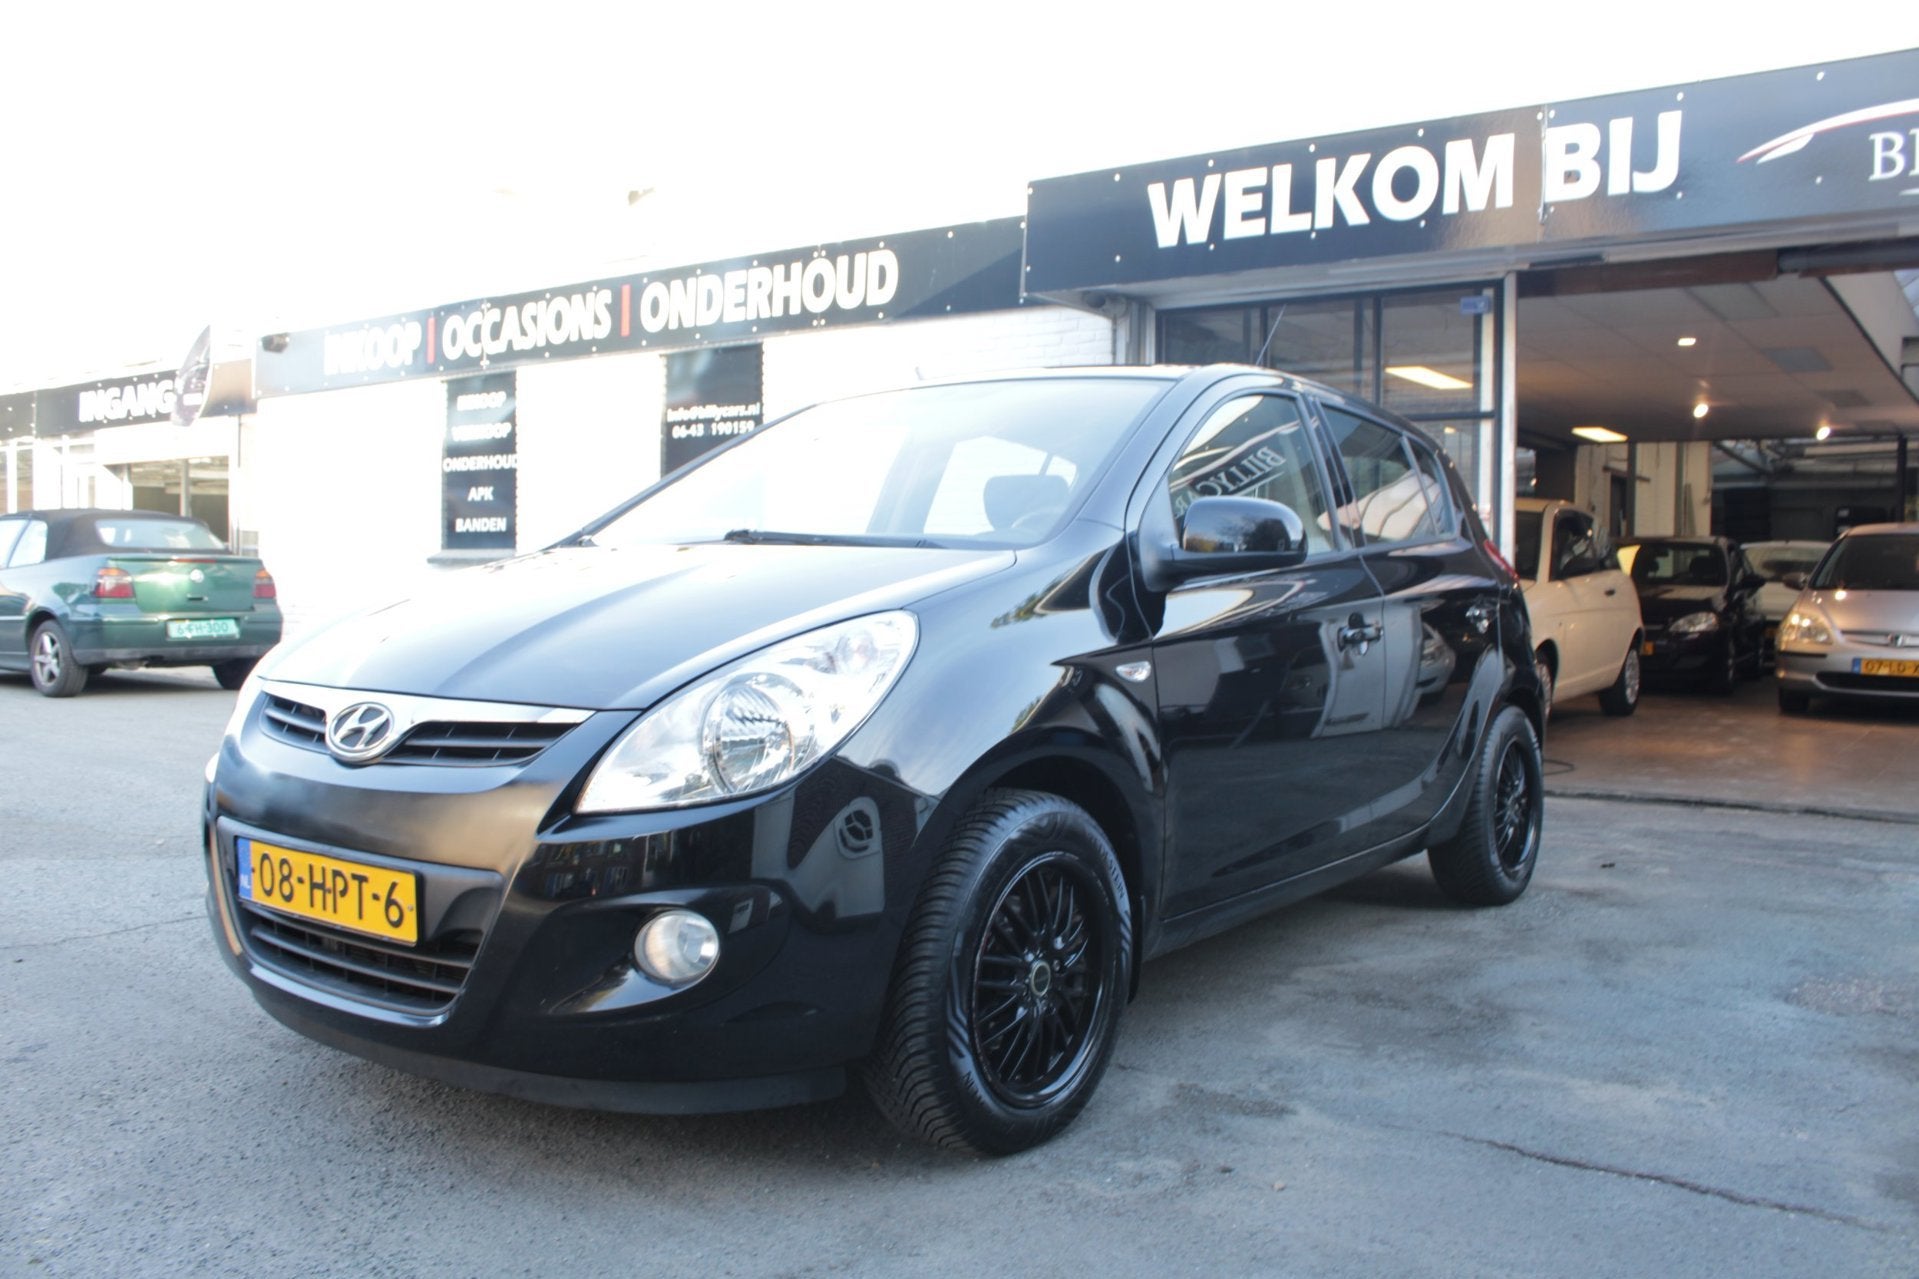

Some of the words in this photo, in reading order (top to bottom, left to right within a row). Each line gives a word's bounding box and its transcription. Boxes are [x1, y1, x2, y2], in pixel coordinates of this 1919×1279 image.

[1147, 132, 1515, 249] WELKOM
[1543, 110, 1682, 203] BIJ
[442, 289, 612, 360] OCCASIONS
[640, 249, 899, 334] ONDERHOUD
[78, 379, 176, 423] INGANG
[443, 454, 518, 472] ONDERHOUD
[467, 486, 494, 501] APK
[455, 517, 507, 532] BANDEN
[259, 852, 405, 929] 08-HPT-6
